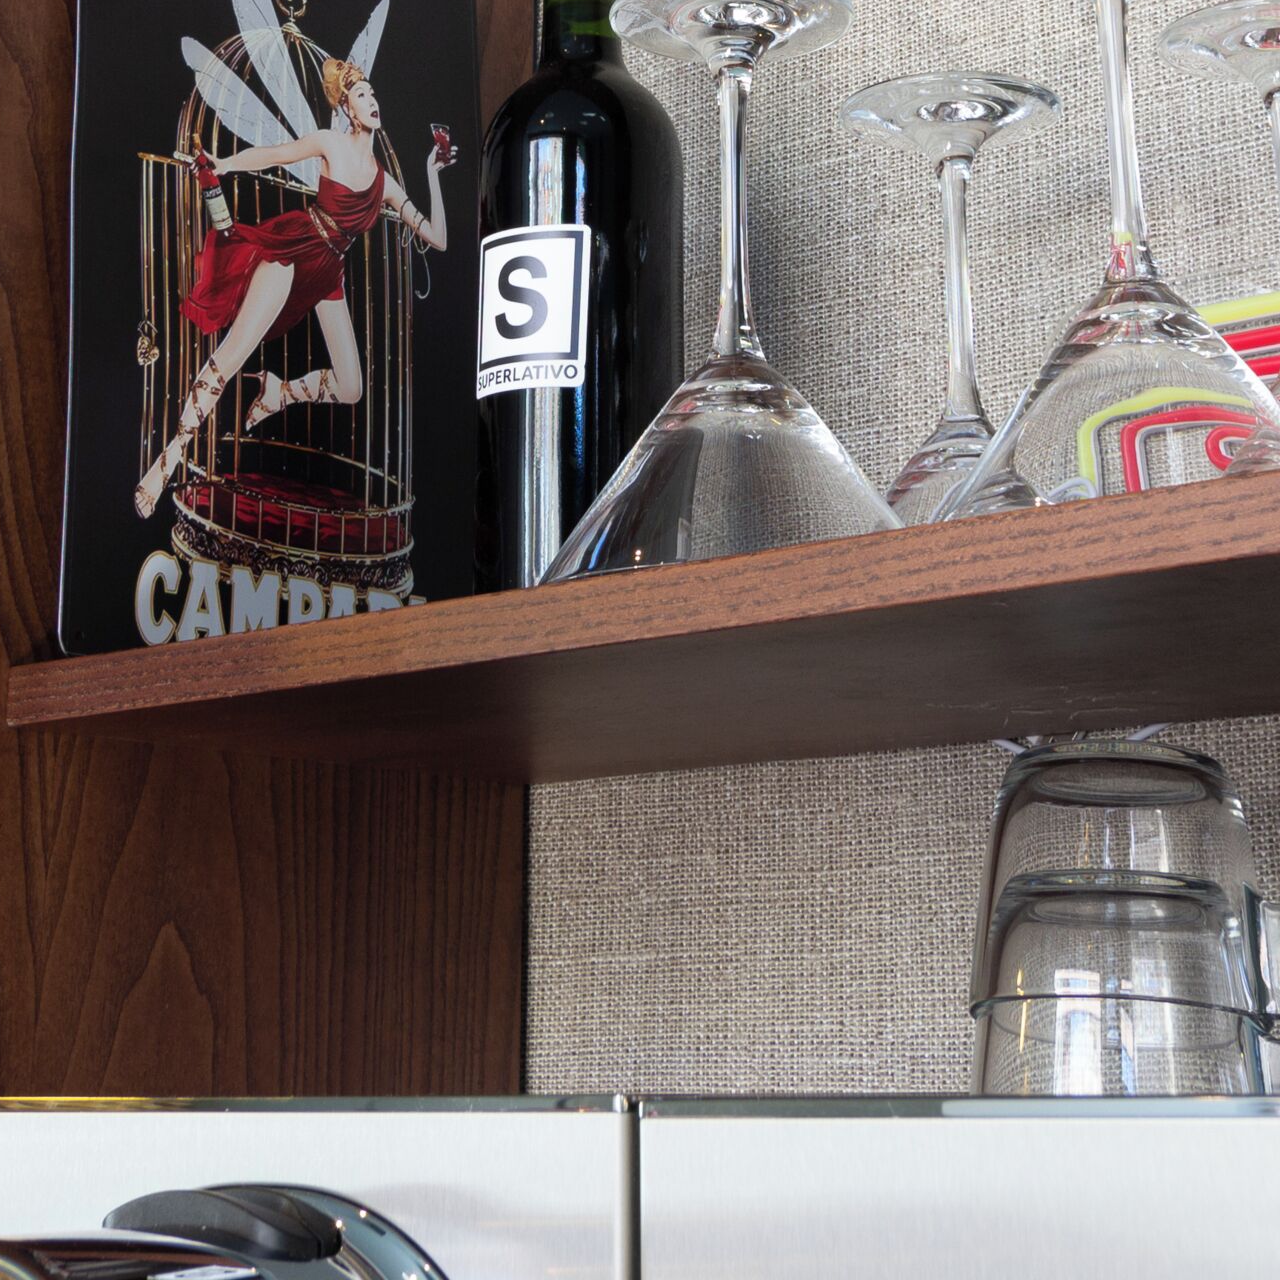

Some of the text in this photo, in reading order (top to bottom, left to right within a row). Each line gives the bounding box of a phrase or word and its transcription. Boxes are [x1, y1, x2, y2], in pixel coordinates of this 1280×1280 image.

[494, 255, 549, 340] S
[477, 364, 578, 392] SUPERLATIVO
[134, 549, 428, 647] CAMP
